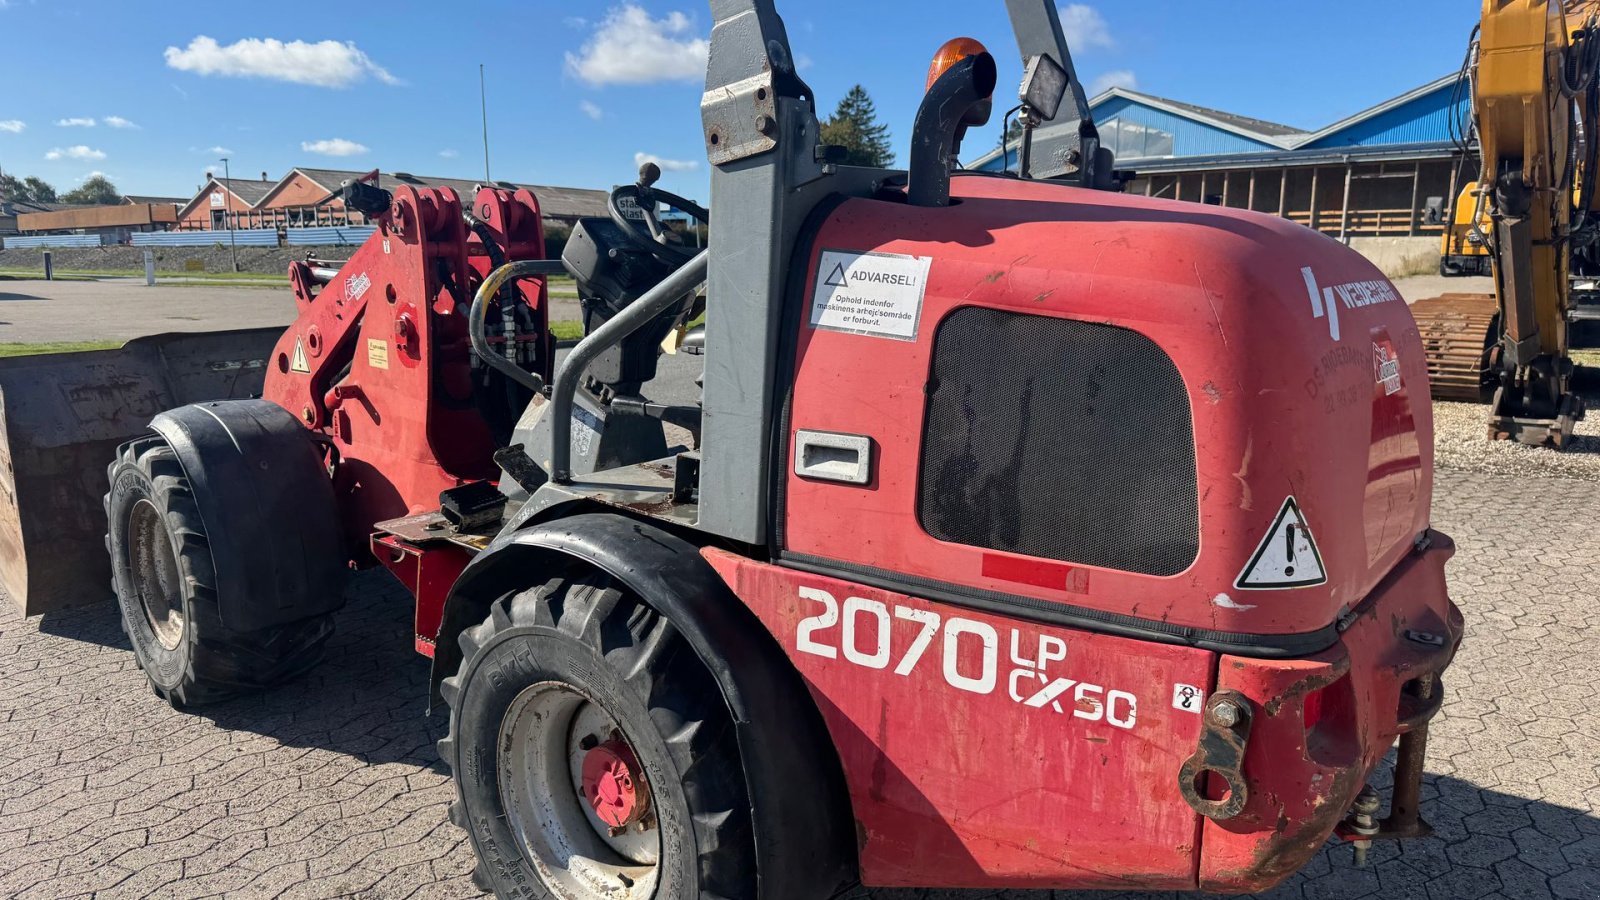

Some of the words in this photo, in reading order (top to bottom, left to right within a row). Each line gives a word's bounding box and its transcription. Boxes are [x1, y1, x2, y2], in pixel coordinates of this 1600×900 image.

[619, 198, 640, 209] sta
[850, 270, 917, 287] ADVARSEL!
[816, 303, 855, 314] maskinens
[835, 294, 862, 306] Ophold
[862, 297, 895, 309] indenfor
[842, 315, 851, 323] er
[795, 584, 1000, 696] 2070
[1009, 627, 1068, 672] LP
[486, 648, 537, 688] BKT
[1007, 668, 1138, 730] CX50
